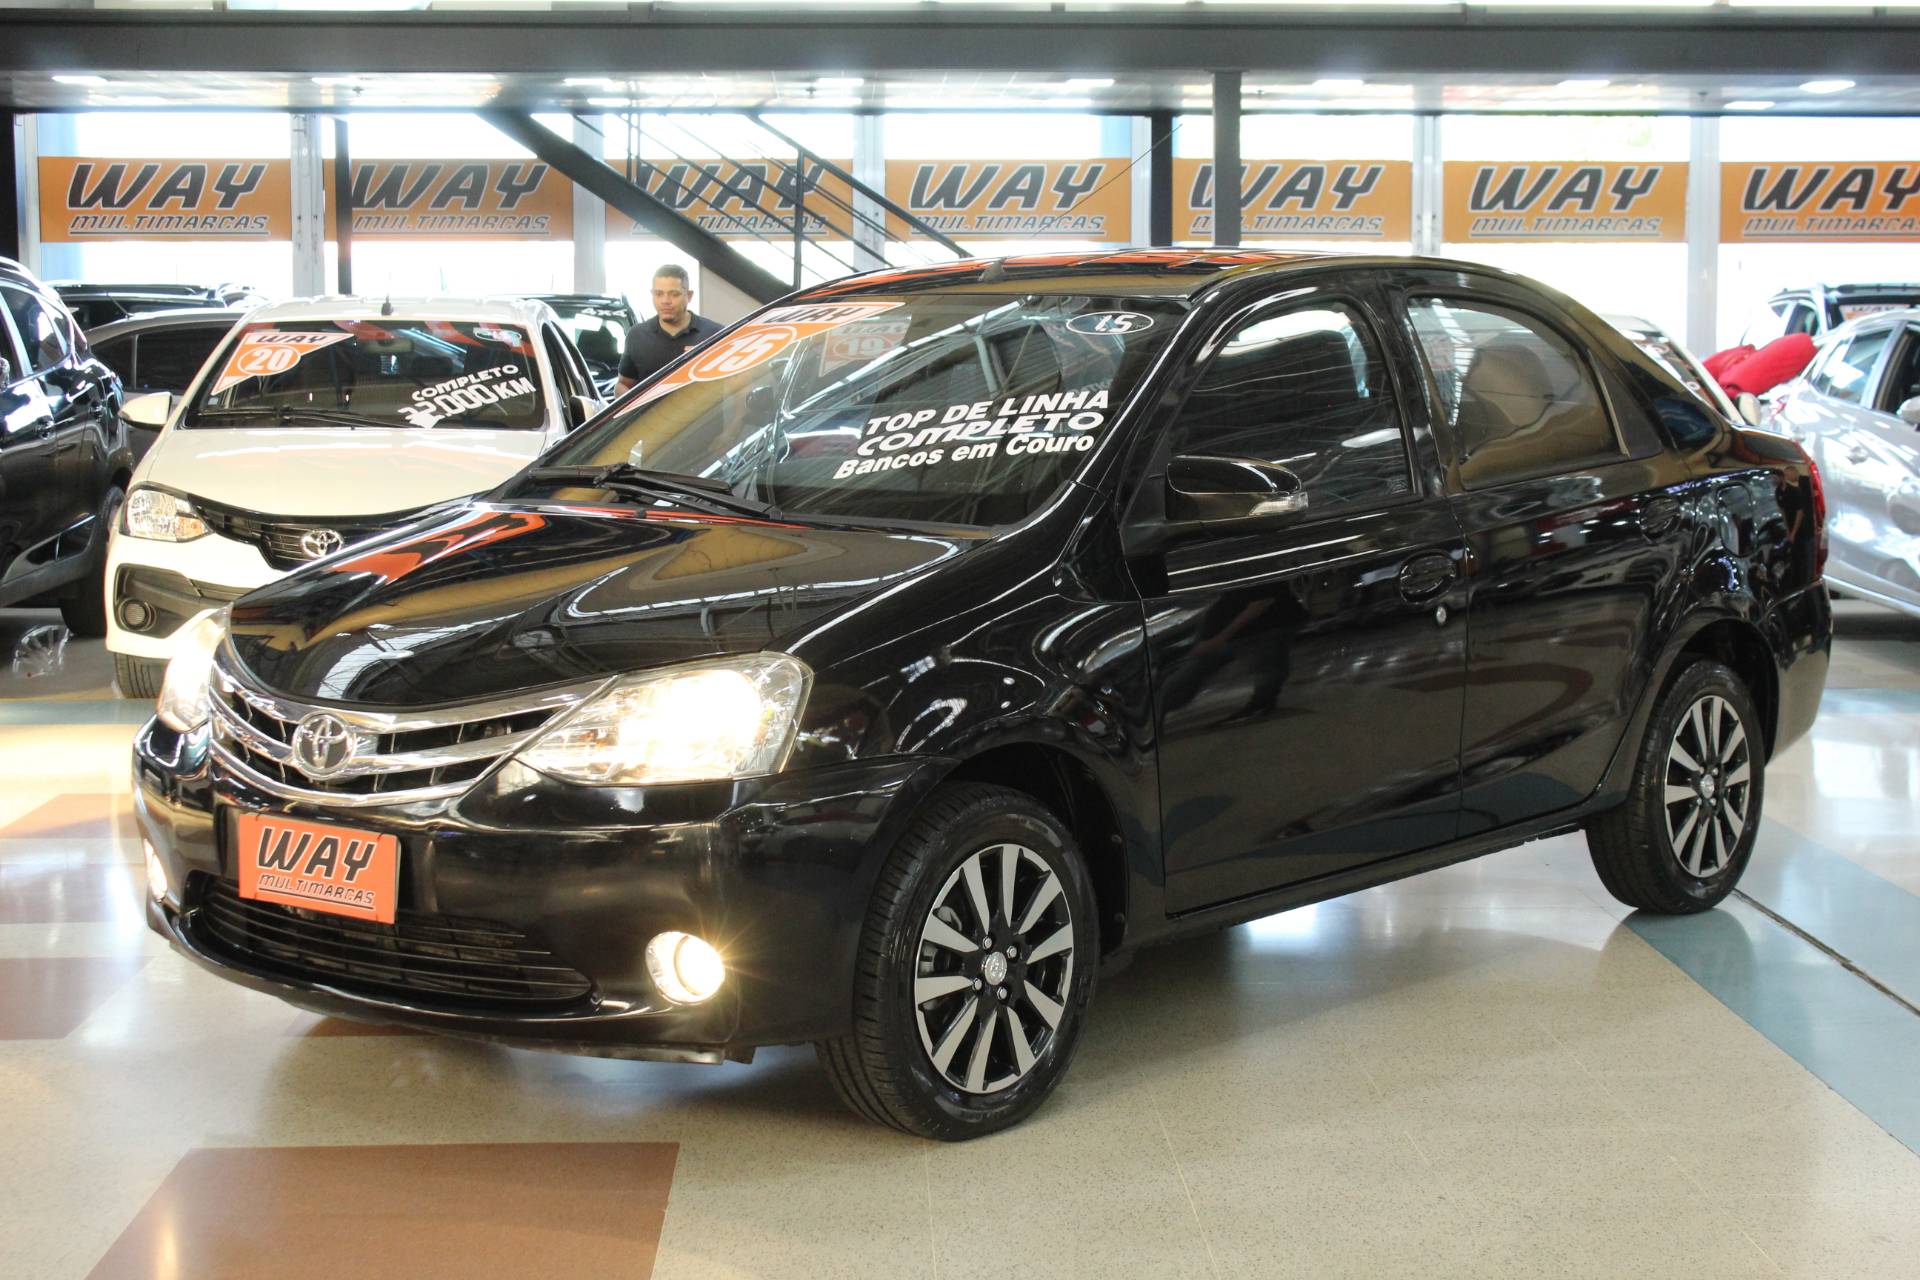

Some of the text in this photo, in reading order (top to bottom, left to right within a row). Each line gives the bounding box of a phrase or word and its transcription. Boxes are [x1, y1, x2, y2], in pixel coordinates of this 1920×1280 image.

[67, 163, 269, 210] WAY
[352, 163, 549, 210] WAY
[908, 163, 1106, 210] WAY
[1468, 165, 1663, 212] WAY
[1741, 166, 1920, 213] WAY
[69, 215, 269, 230] MULTIMARCAS
[353, 215, 549, 230] MULTIMARCAS
[1471, 217, 1662, 231] MULTIMARCAS
[1744, 217, 1920, 231] MULTIMARCA
[244, 348, 294, 371] 20
[255, 335, 328, 344] WAY
[700, 331, 792, 373] 15
[411, 364, 519, 401] COMPLETO
[857, 411, 1105, 457] COMPLETO
[866, 390, 1109, 436] TOP DE LINHA
[833, 433, 1095, 480] Bancos em Couro
[257, 826, 377, 884] WAY
[258, 874, 375, 905] MULTIMARCAS
